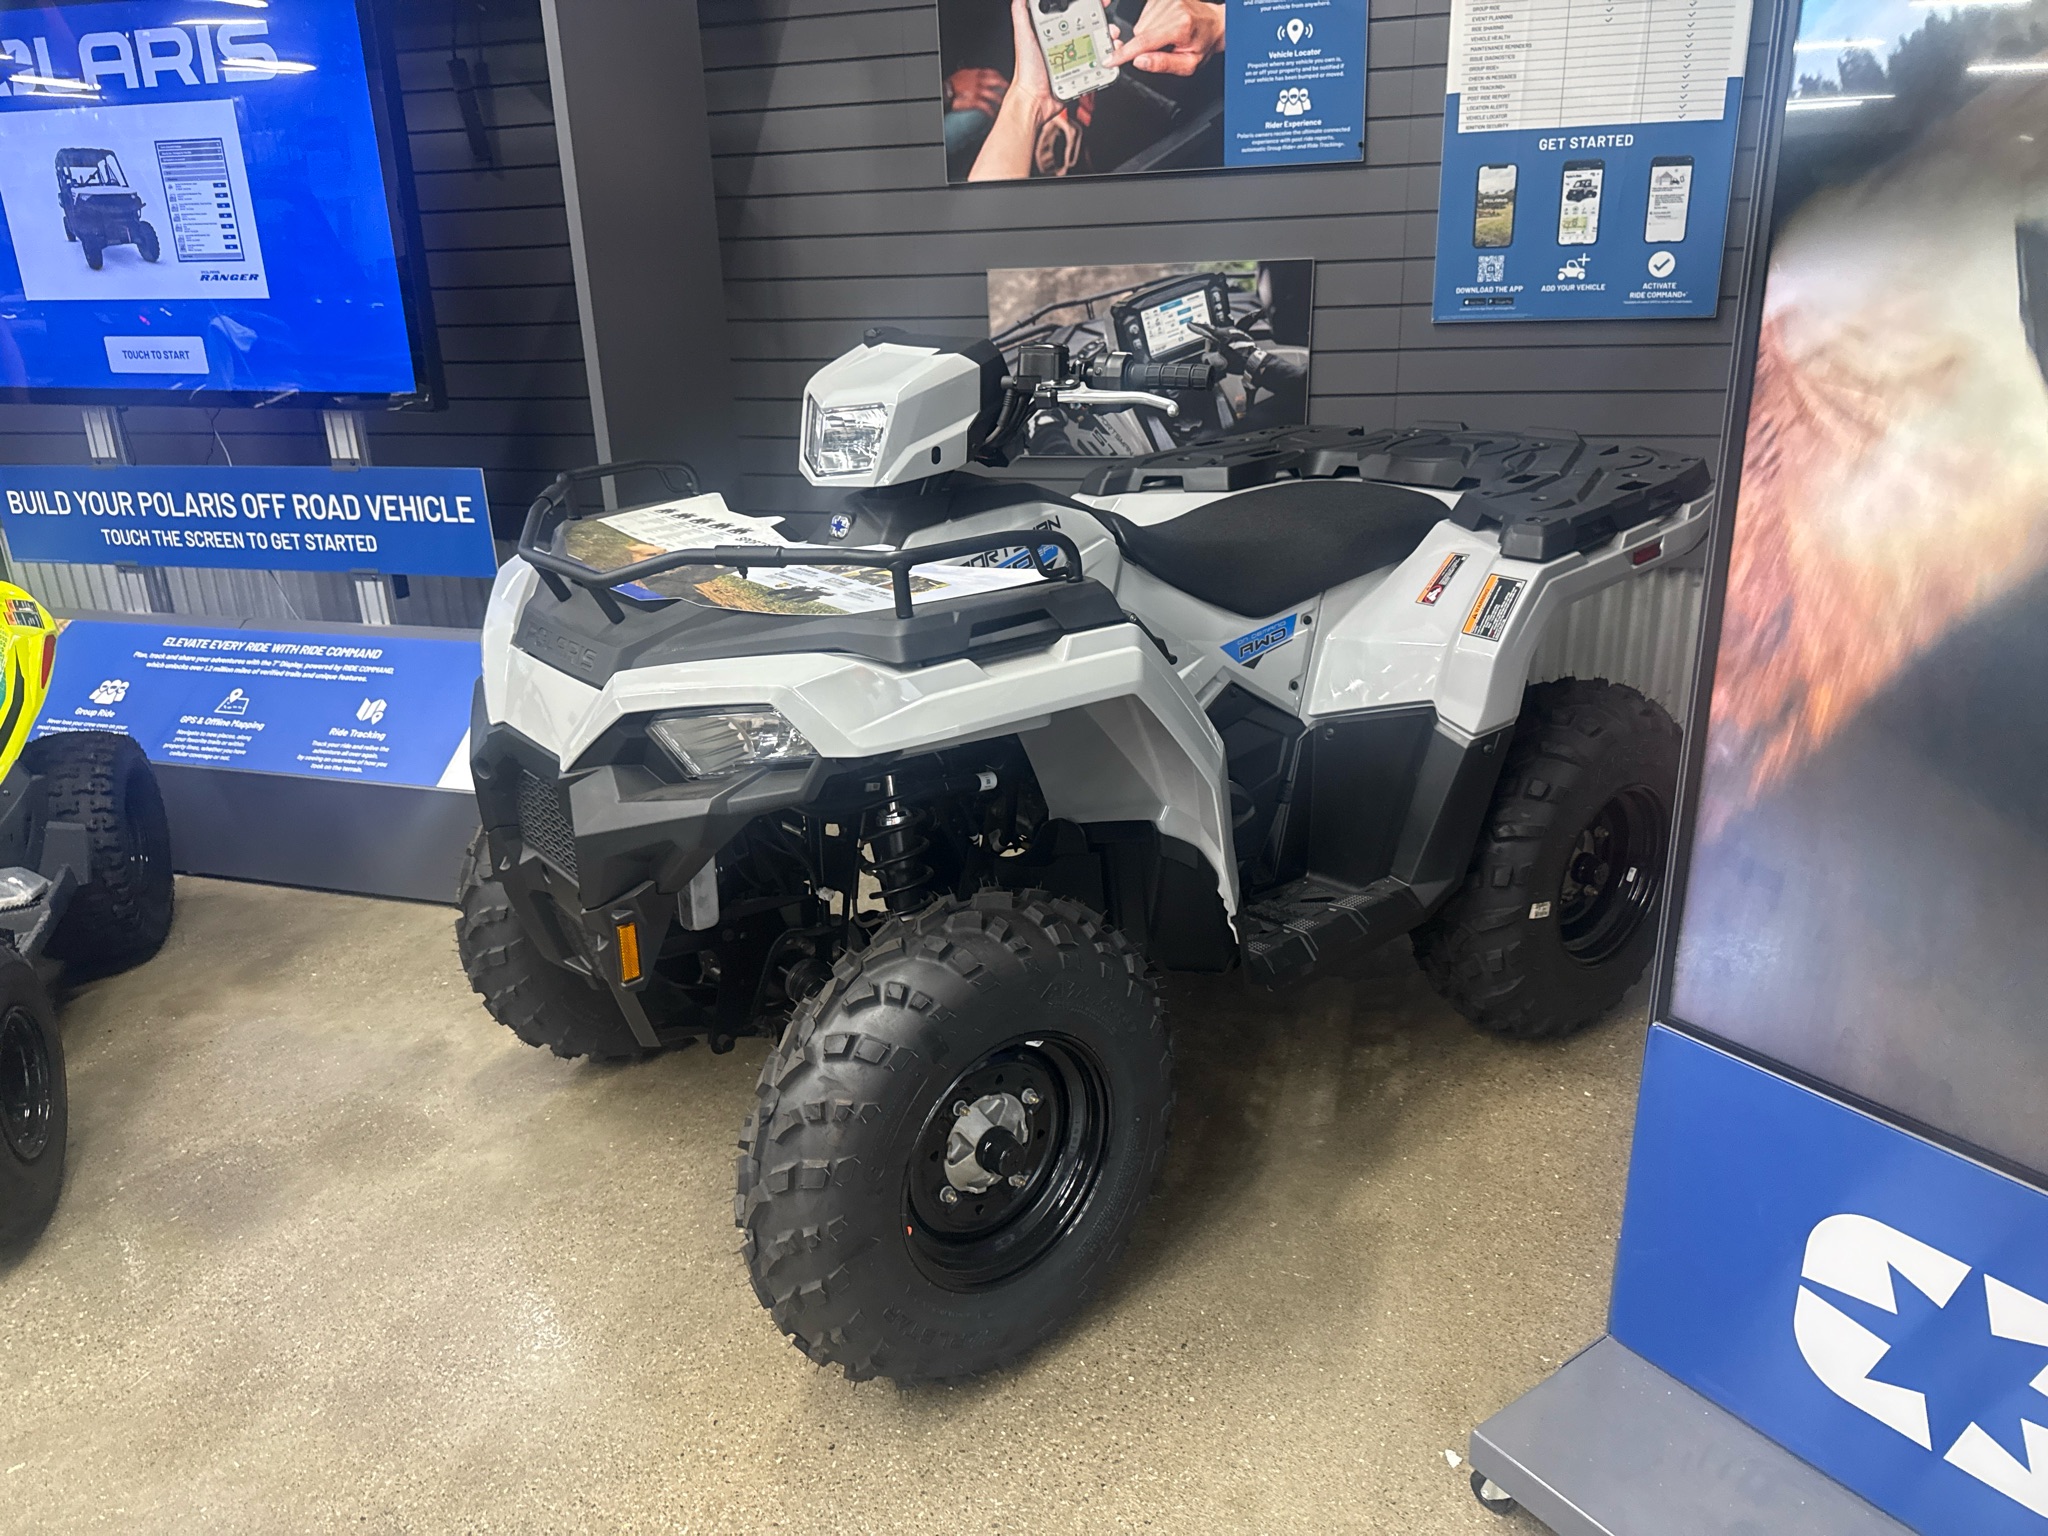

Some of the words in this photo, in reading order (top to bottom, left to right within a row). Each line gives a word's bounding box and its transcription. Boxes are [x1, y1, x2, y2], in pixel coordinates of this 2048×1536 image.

[1269, 50, 1293, 59] Vehicle
[1295, 49, 1321, 57] Locator
[1265, 121, 1282, 129] Rider
[1284, 120, 1321, 128] Experience
[1539, 138, 1566, 150] GET
[1570, 134, 1633, 148] STARTED
[200, 273, 259, 281] RANGER
[1456, 286, 1493, 294] DOWNLOAD
[122, 350, 150, 359] TOUCH
[151, 350, 162, 359] TO
[164, 351, 189, 359] START
[6, 491, 71, 515] BUILD
[73, 491, 136, 516] YOUR
[137, 492, 237, 518] POLARIS
[241, 493, 286, 519] OFF
[292, 494, 361, 521] ROAD
[364, 495, 475, 523] VEHICLE
[101, 528, 150, 546] TOUCH
[152, 530, 183, 547] THE
[184, 531, 245, 549] SCREEN
[246, 532, 268, 550] TO
[271, 533, 300, 550] GET
[305, 533, 377, 552] STARTED
[163, 637, 211, 648] ELEVATE
[209, 639, 246, 651] EVERY
[244, 642, 272, 652] RIDE
[271, 643, 301, 654] WITH
[299, 645, 327, 656] RIDE
[326, 647, 382, 659] COMMAND
[1240, 627, 1287, 658] AWD
[211, 657, 246, 665] adventures
[285, 670, 302, 678] trails
[338, 674, 367, 682] features.
[74, 707, 97, 717] Group
[97, 709, 115, 717] Ride
[180, 716, 197, 724] GPS
[197, 717, 204, 725] &
[204, 718, 230, 726] Offline
[231, 720, 265, 731] Mapping
[328, 728, 349, 736] Ride
[350, 729, 386, 741] Tracking
